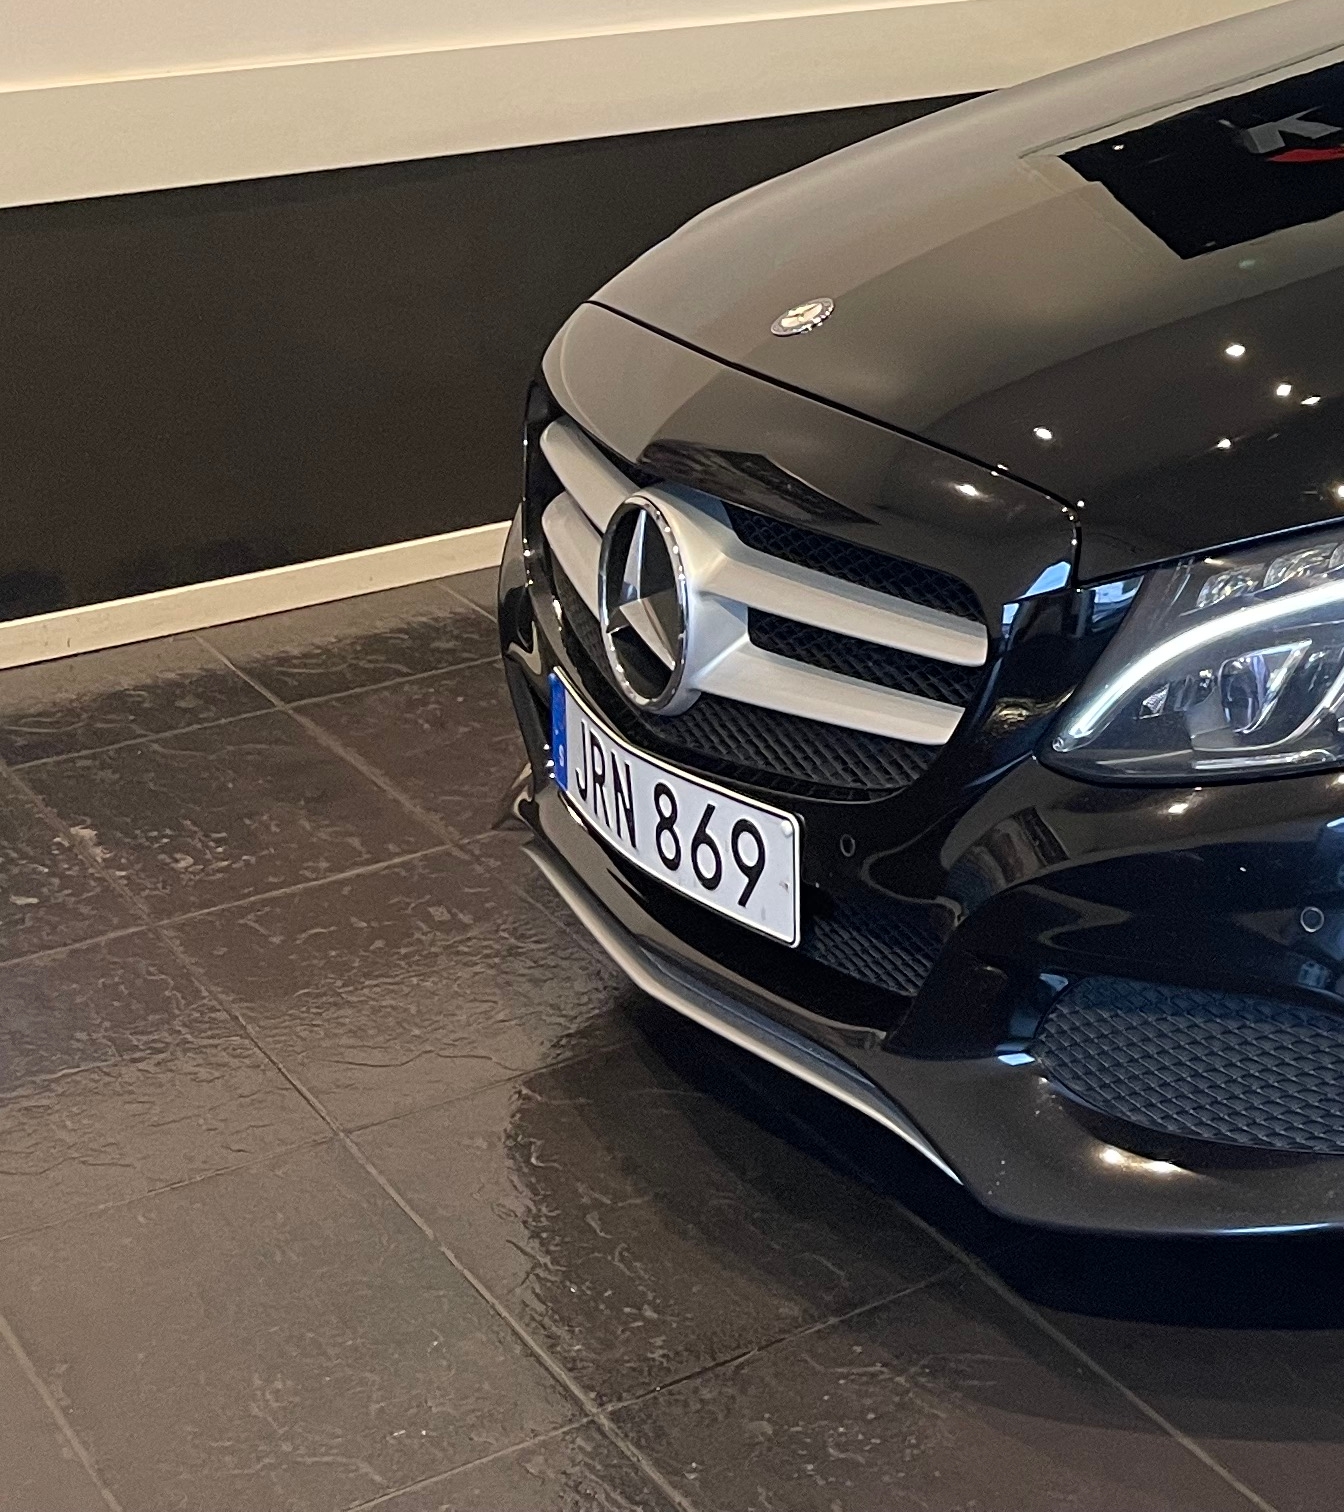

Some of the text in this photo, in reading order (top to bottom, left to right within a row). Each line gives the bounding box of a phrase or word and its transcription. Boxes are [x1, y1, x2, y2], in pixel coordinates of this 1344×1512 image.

[558, 744, 566, 768] S
[575, 718, 766, 908] JRN 869
